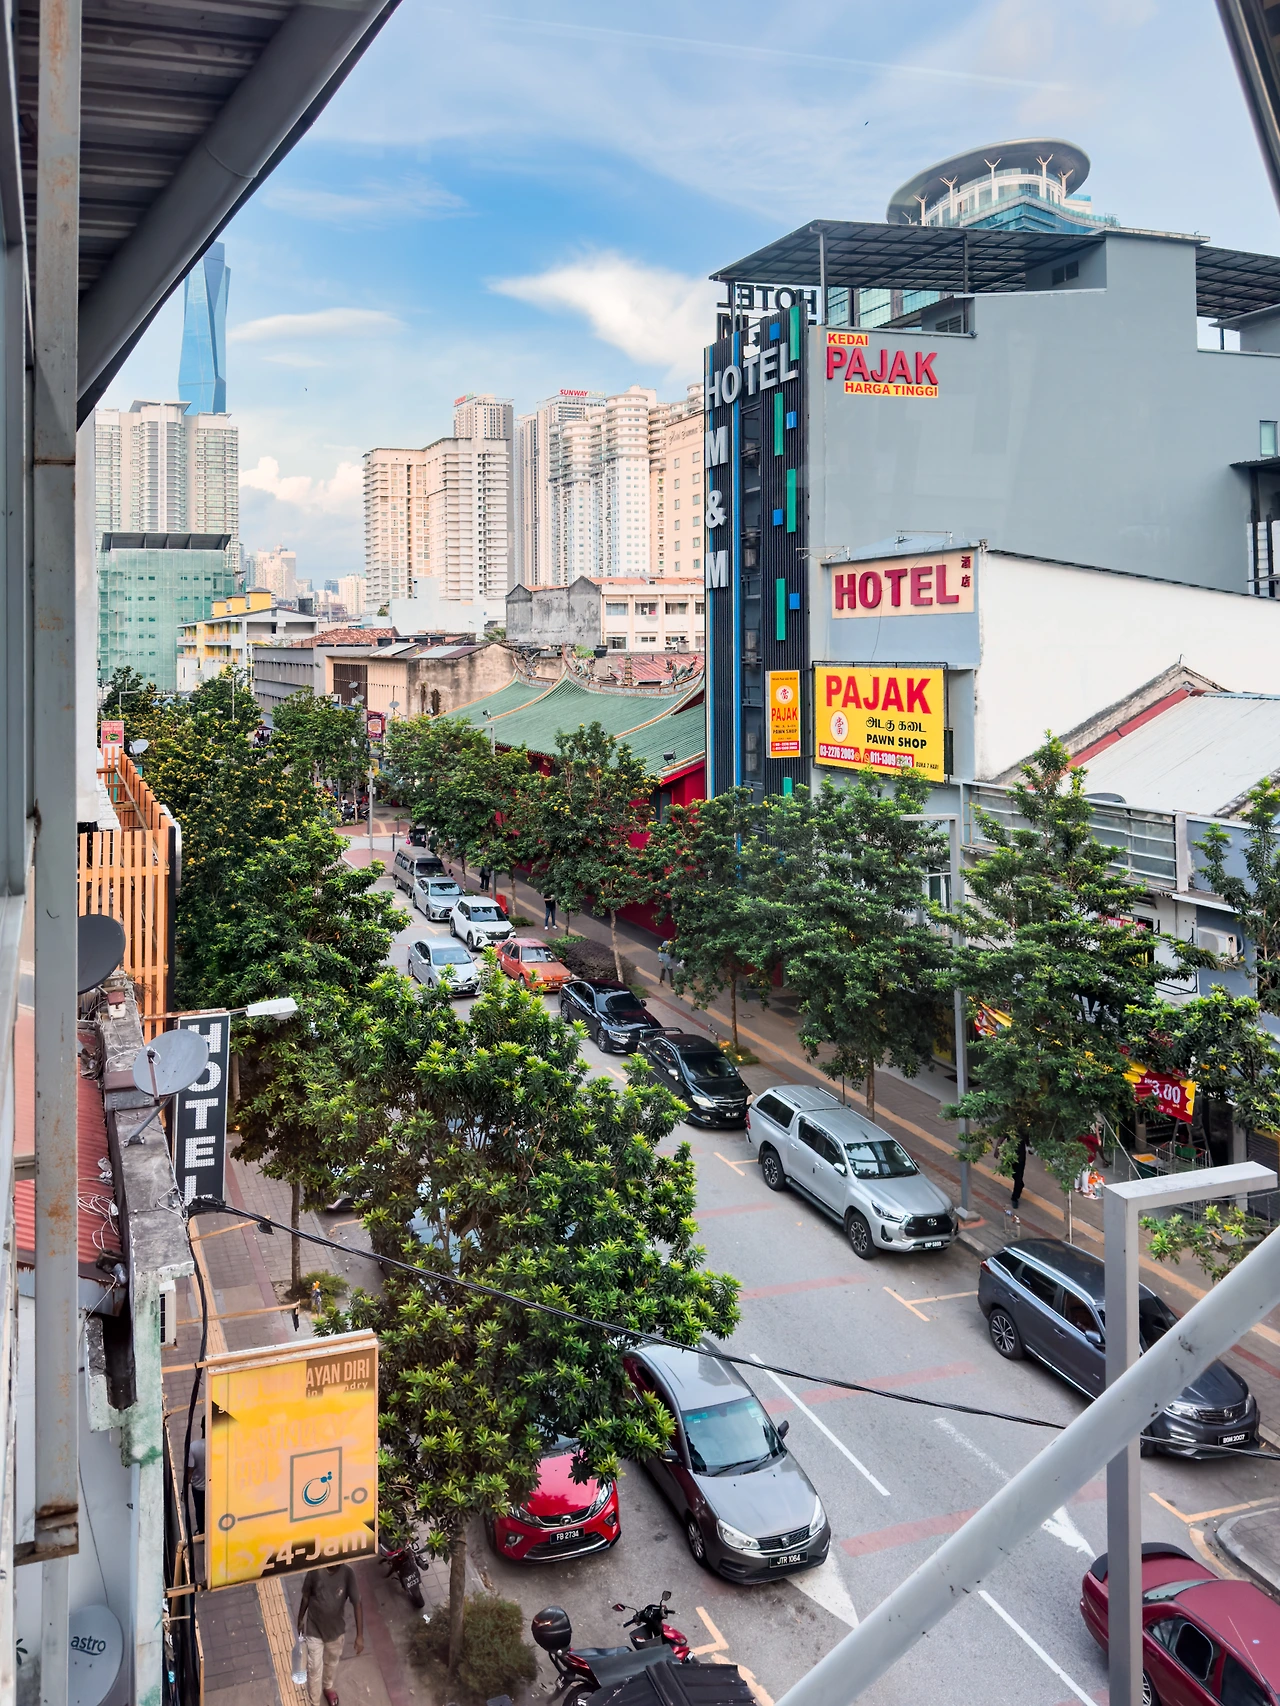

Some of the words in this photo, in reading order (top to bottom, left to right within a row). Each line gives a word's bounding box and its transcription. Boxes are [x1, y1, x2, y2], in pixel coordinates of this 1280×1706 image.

[828, 333, 868, 345] KEDAI
[827, 346, 938, 385] PAJAK
[705, 342, 798, 411] HOTEL
[559, 388, 588, 397] SUNWAY
[845, 382, 890, 394] HARGA
[893, 385, 937, 396] TINGGI
[961, 556, 971, 587] 酒店
[835, 564, 959, 610] HOTEL
[826, 675, 931, 714] PAJAK
[771, 708, 797, 721] PAJAK
[866, 734, 894, 745] PAWN
[898, 737, 927, 749] SHOP
[1152, 1080, 1180, 1103] 3.00
[184, 1023, 222, 1205] HOTEL
[344, 1358, 369, 1381] DIRI
[556, 1533, 564, 1541] FB
[565, 1530, 579, 1540] 2734
[777, 1556, 787, 1564] JTR
[71, 1635, 106, 1653] astro
